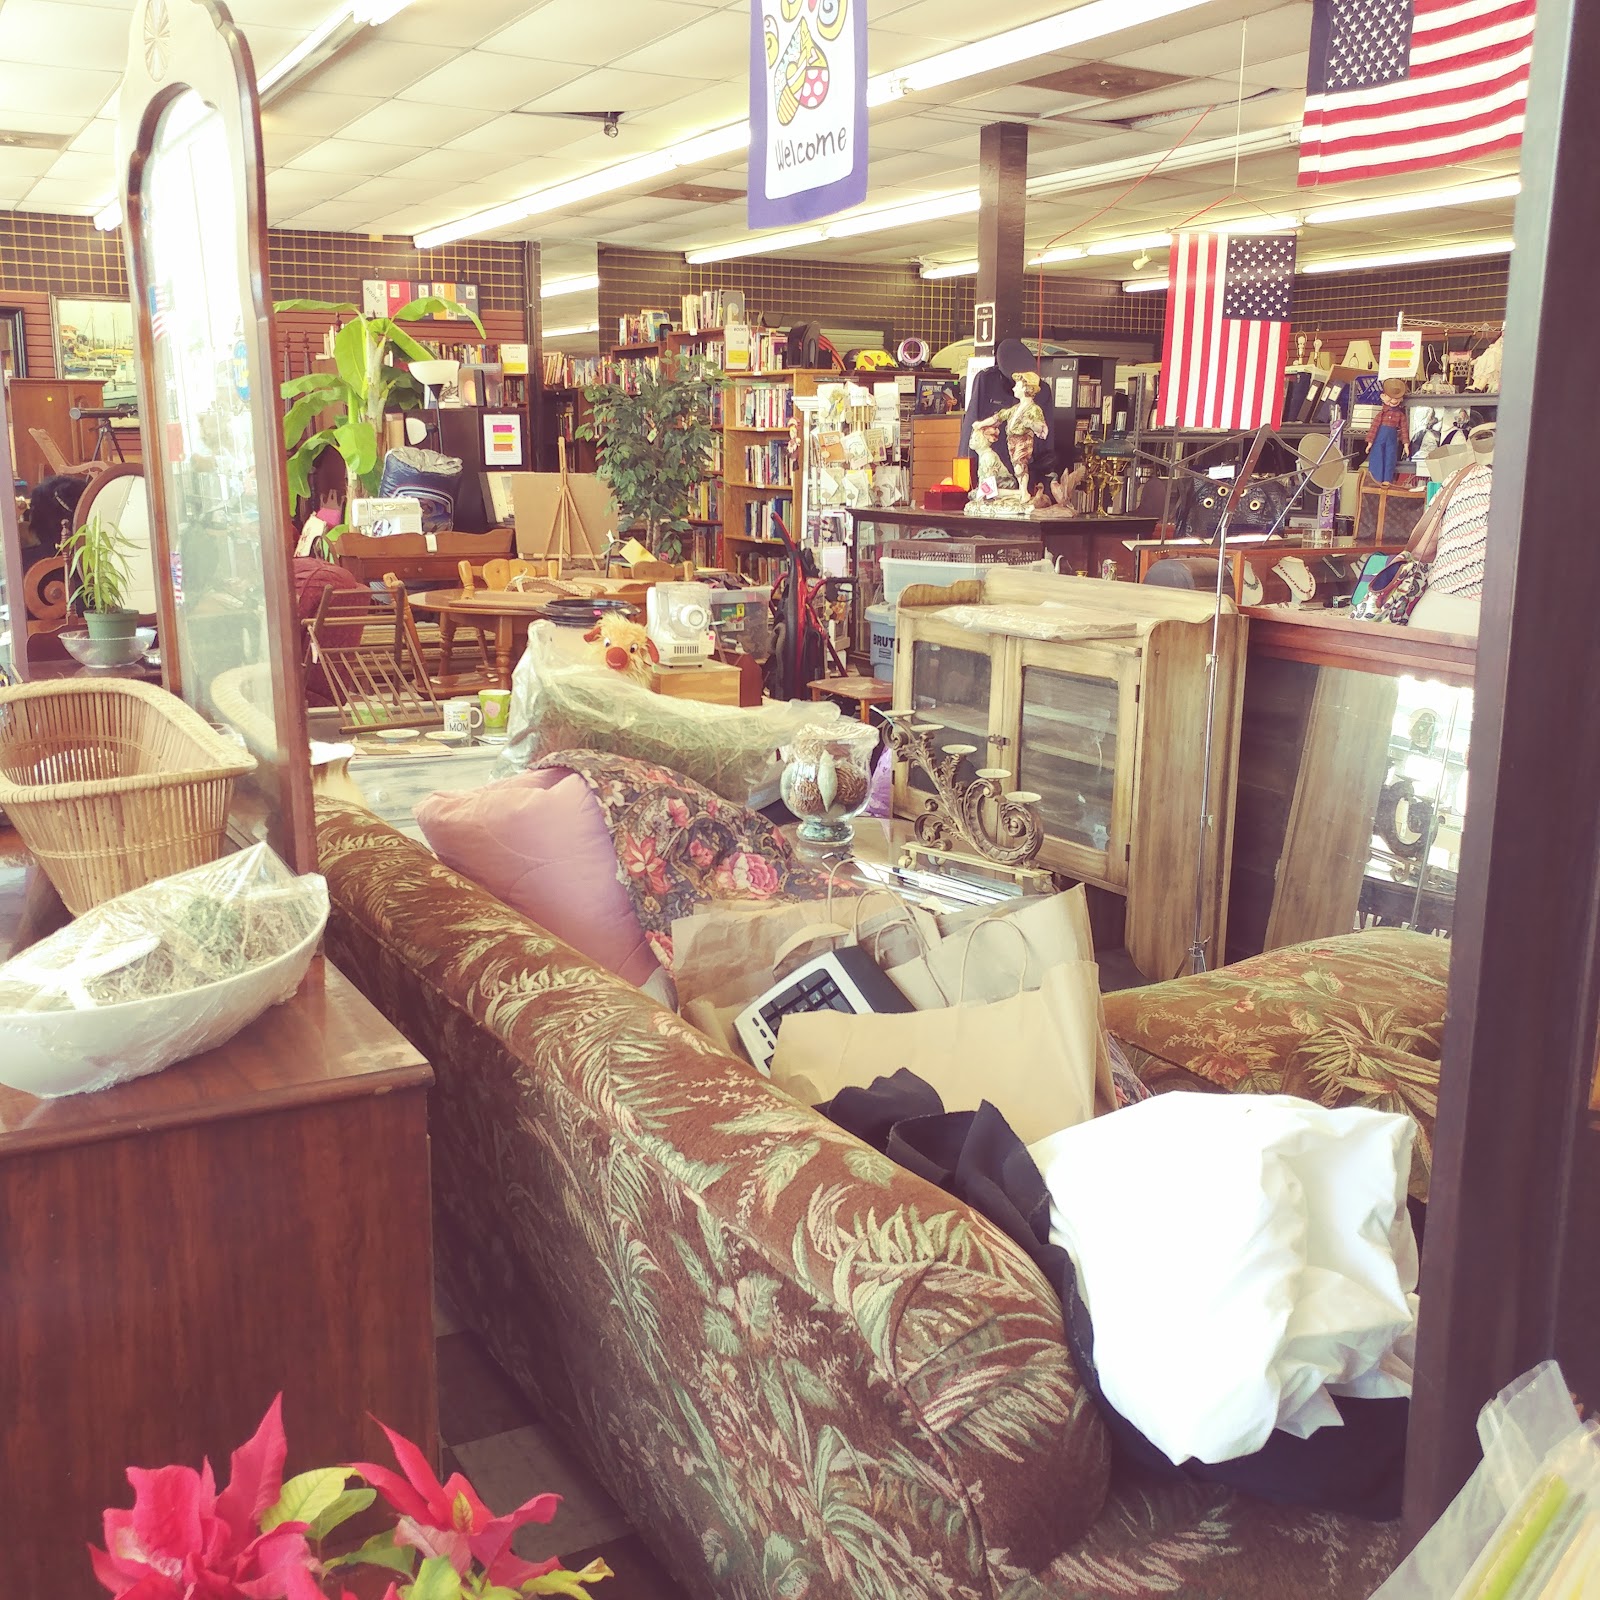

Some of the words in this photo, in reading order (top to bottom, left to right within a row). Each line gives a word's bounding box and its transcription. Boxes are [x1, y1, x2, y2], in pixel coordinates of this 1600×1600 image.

[775, 127, 847, 171] Welcome
[366, 286, 381, 304] BOOKS
[873, 634, 895, 648] BRUT
[449, 722, 468, 731] MOM
